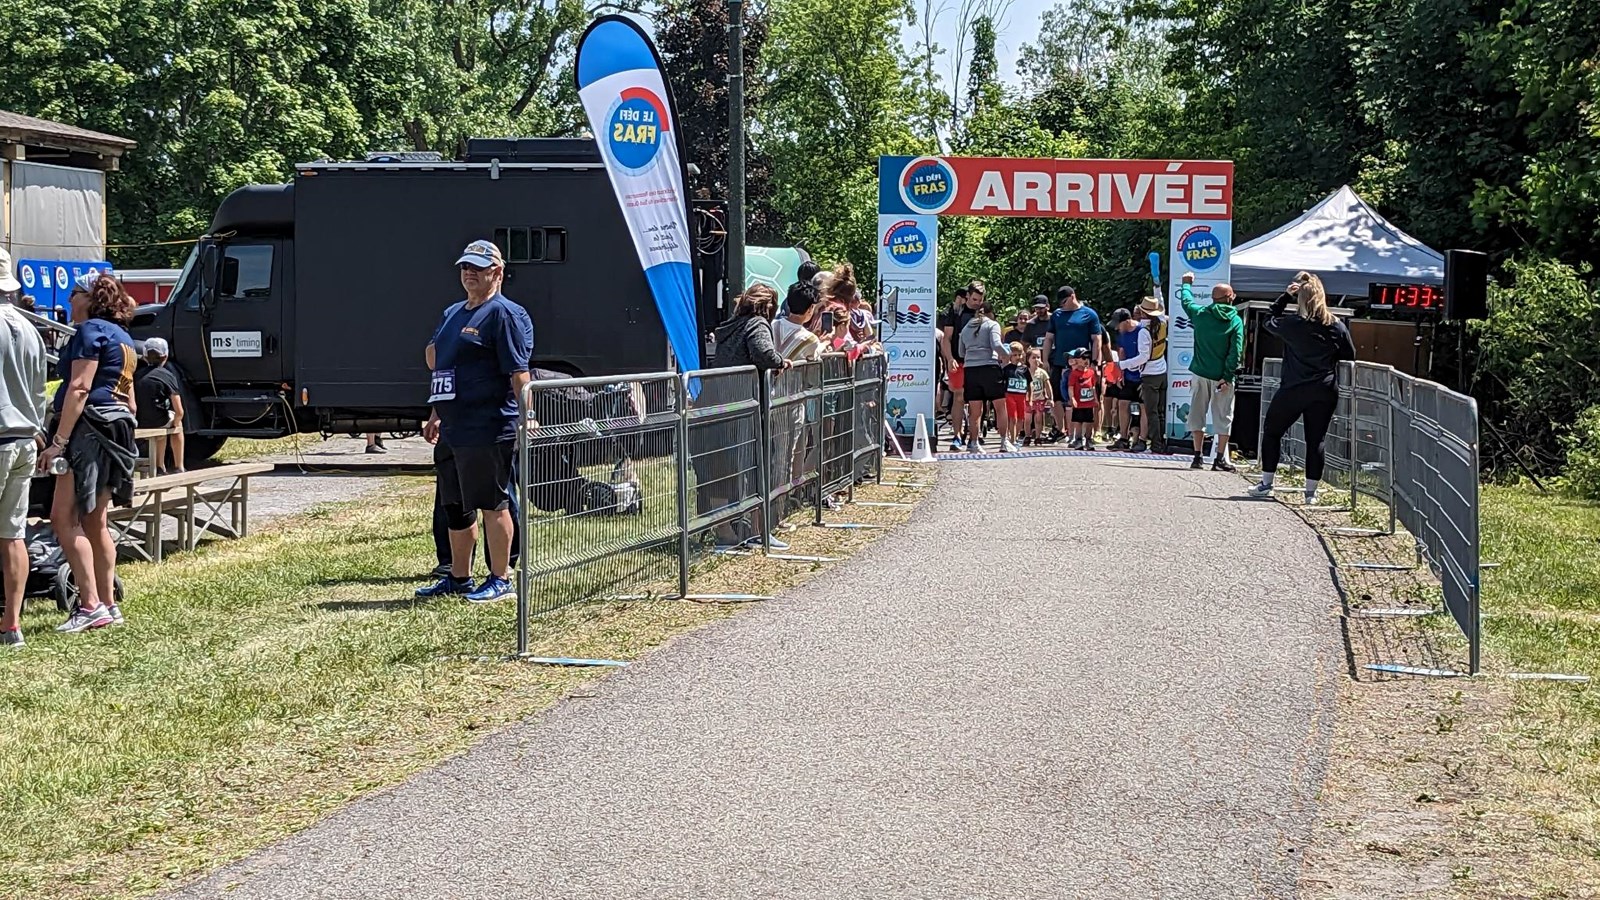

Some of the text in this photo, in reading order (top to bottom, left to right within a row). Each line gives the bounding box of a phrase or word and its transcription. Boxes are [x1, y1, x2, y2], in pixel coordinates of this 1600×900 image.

[925, 173, 942, 182] DÉFI
[913, 181, 946, 196] FRAS
[970, 162, 1227, 215] ARRIVÉE
[904, 234, 919, 243] DÉFI
[1198, 239, 1213, 248] DÉFI
[892, 241, 924, 255] FRAS
[1186, 246, 1217, 260] FRAS
[236, 337, 260, 349] timing
[887, 373, 914, 382] etro
[897, 377, 930, 388] Daoust
